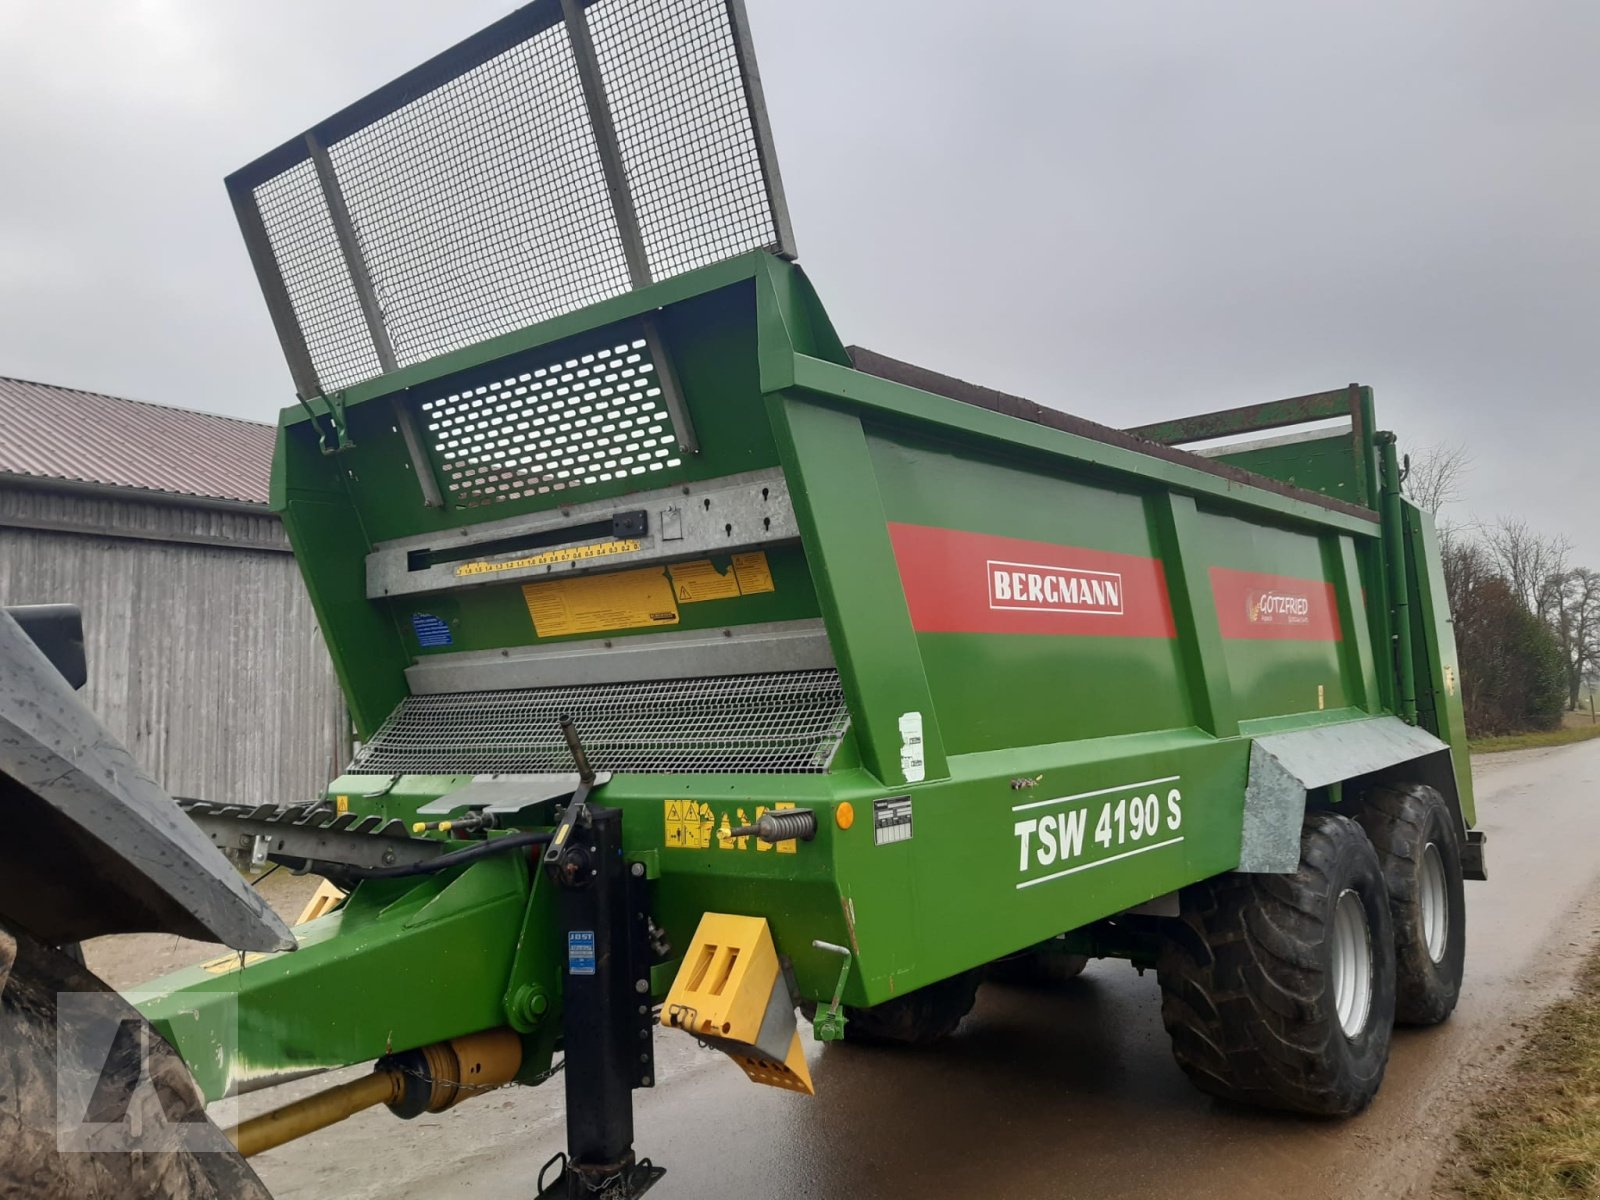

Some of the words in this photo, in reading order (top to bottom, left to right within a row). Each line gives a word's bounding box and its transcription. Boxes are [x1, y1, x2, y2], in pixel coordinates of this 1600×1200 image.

[994, 570, 1119, 607] BERGMANN
[1260, 591, 1308, 616] GÖTZFRIED
[1013, 808, 1088, 872] TSW
[1094, 793, 1160, 849] 4190
[1166, 788, 1182, 831] S
